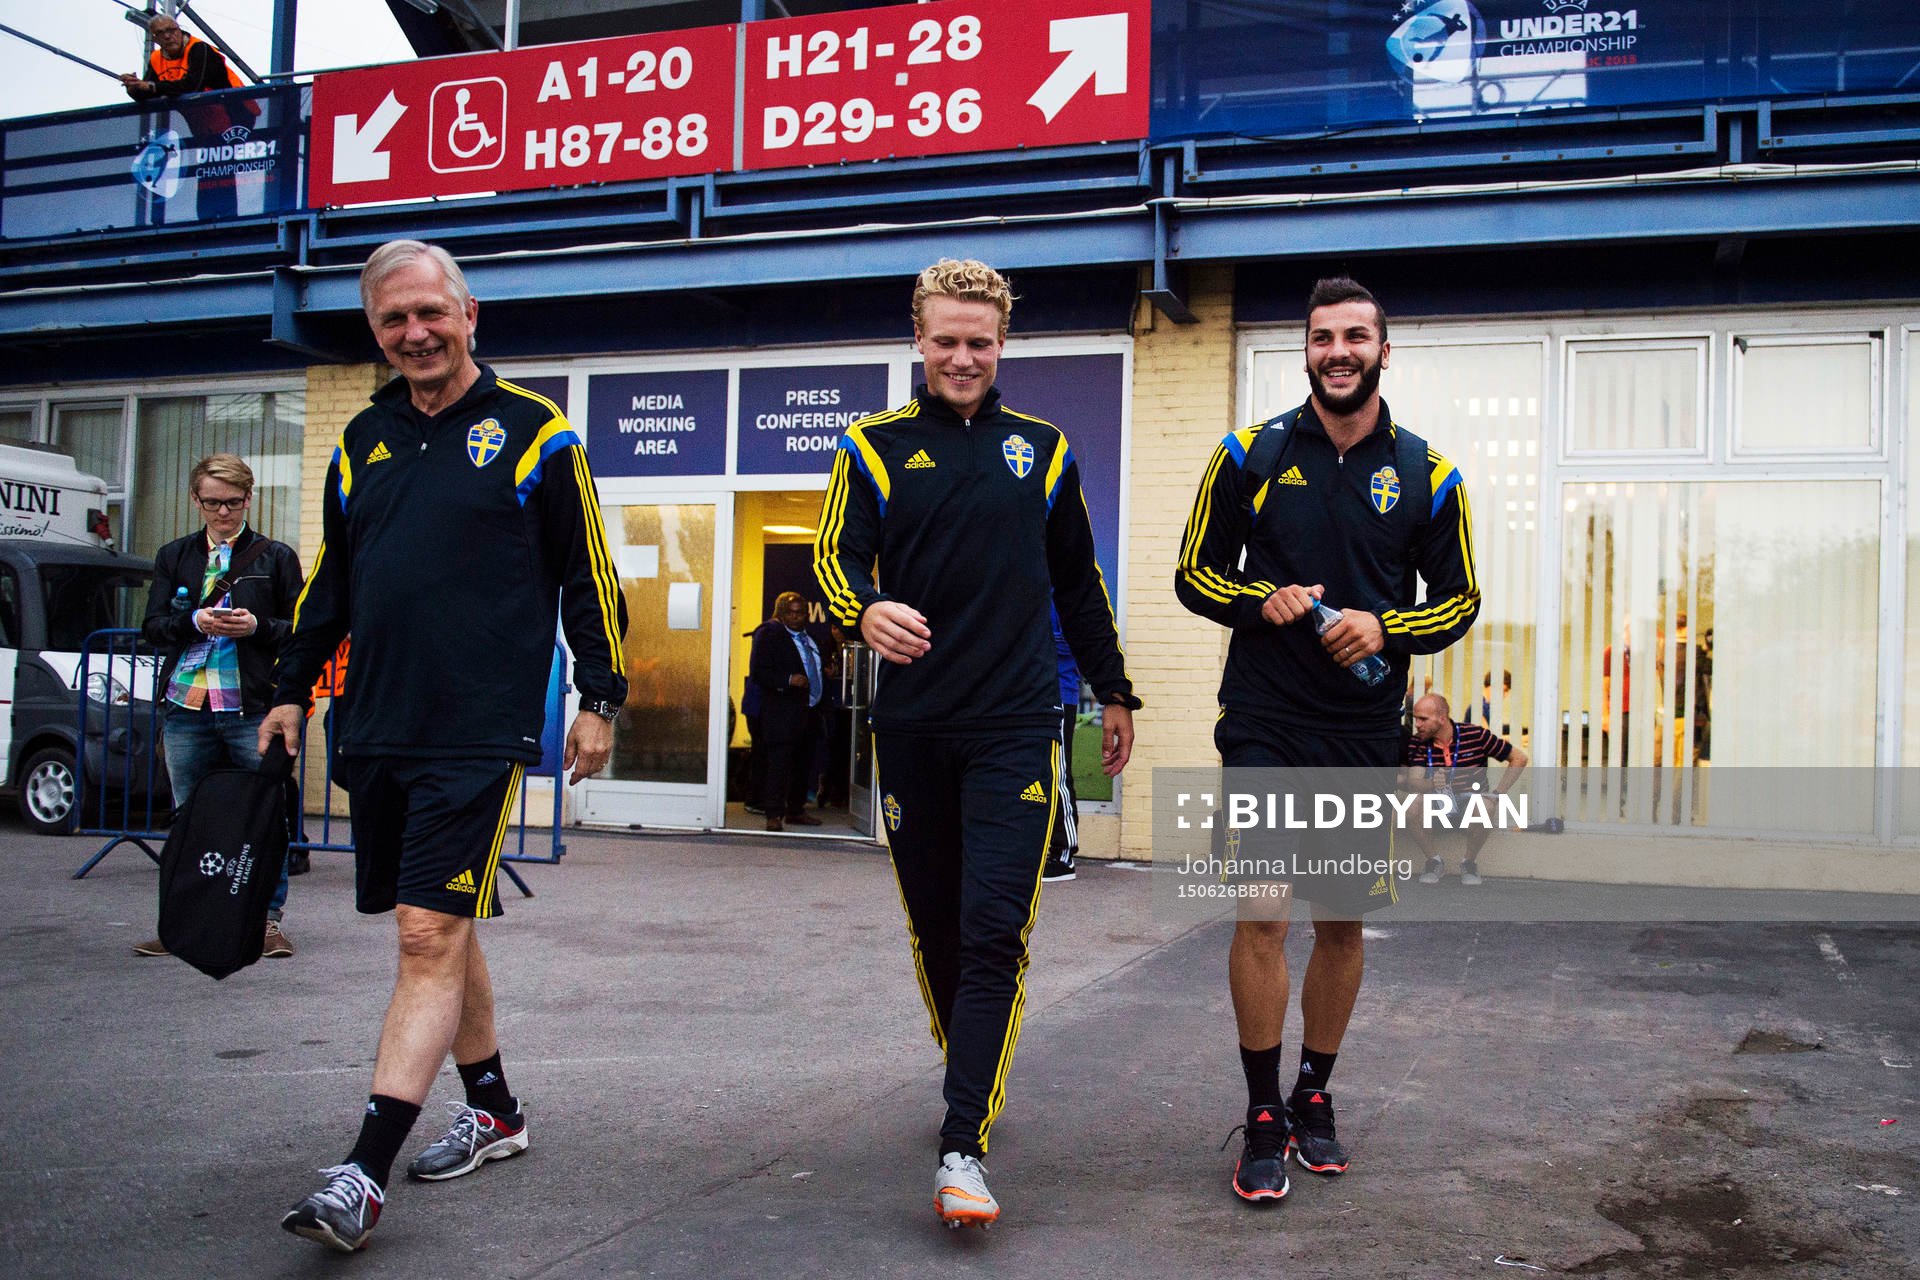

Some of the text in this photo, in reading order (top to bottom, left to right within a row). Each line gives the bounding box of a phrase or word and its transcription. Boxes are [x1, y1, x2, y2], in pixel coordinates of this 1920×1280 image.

[1500, 9, 1637, 40] UNDER21
[1500, 35, 1637, 57] CHAMPIONSHIP
[536, 46, 693, 103] A1-20
[223, 128, 249, 141] UEFA
[524, 113, 709, 170] H87-88
[196, 140, 276, 164] UNDER21
[195, 159, 276, 179] CHAMPIONSHIP
[632, 395, 684, 410] MEDIA
[786, 390, 840, 405] PRESS
[618, 417, 696, 433] WORKING
[634, 440, 678, 455] AREA
[786, 436, 838, 451] ROOM
[905, 461, 936, 469] adidas
[1278, 477, 1307, 486] adidas
[1020, 793, 1047, 804] adidas
[230, 844, 251, 894] CHAMPIONS
[446, 883, 477, 894] adidas
